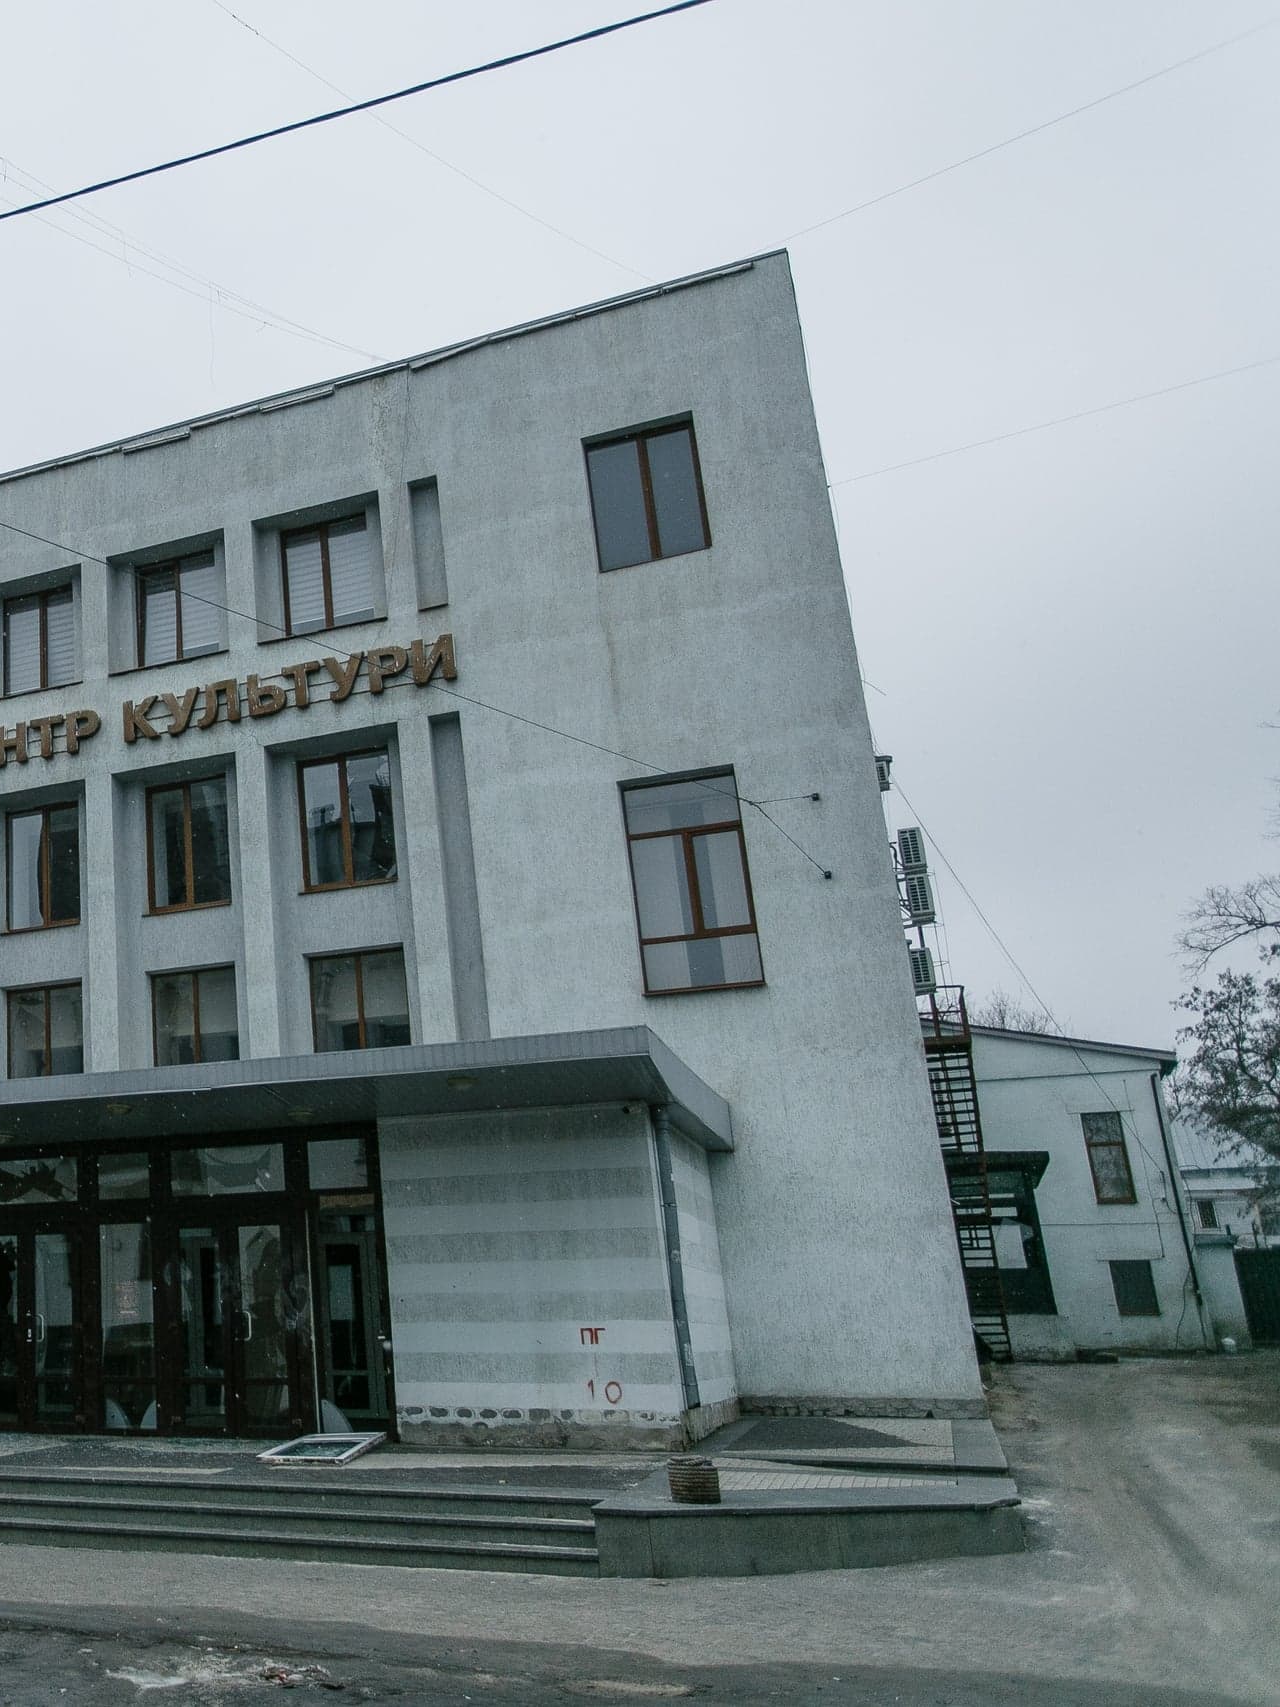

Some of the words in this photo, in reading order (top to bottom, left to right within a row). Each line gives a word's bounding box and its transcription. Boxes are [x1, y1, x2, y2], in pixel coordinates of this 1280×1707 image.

[122, 633, 458, 743] КУЛЬТУРИ
[580, 1327, 606, 1345] ПГ
[587, 1379, 622, 1404] 10
